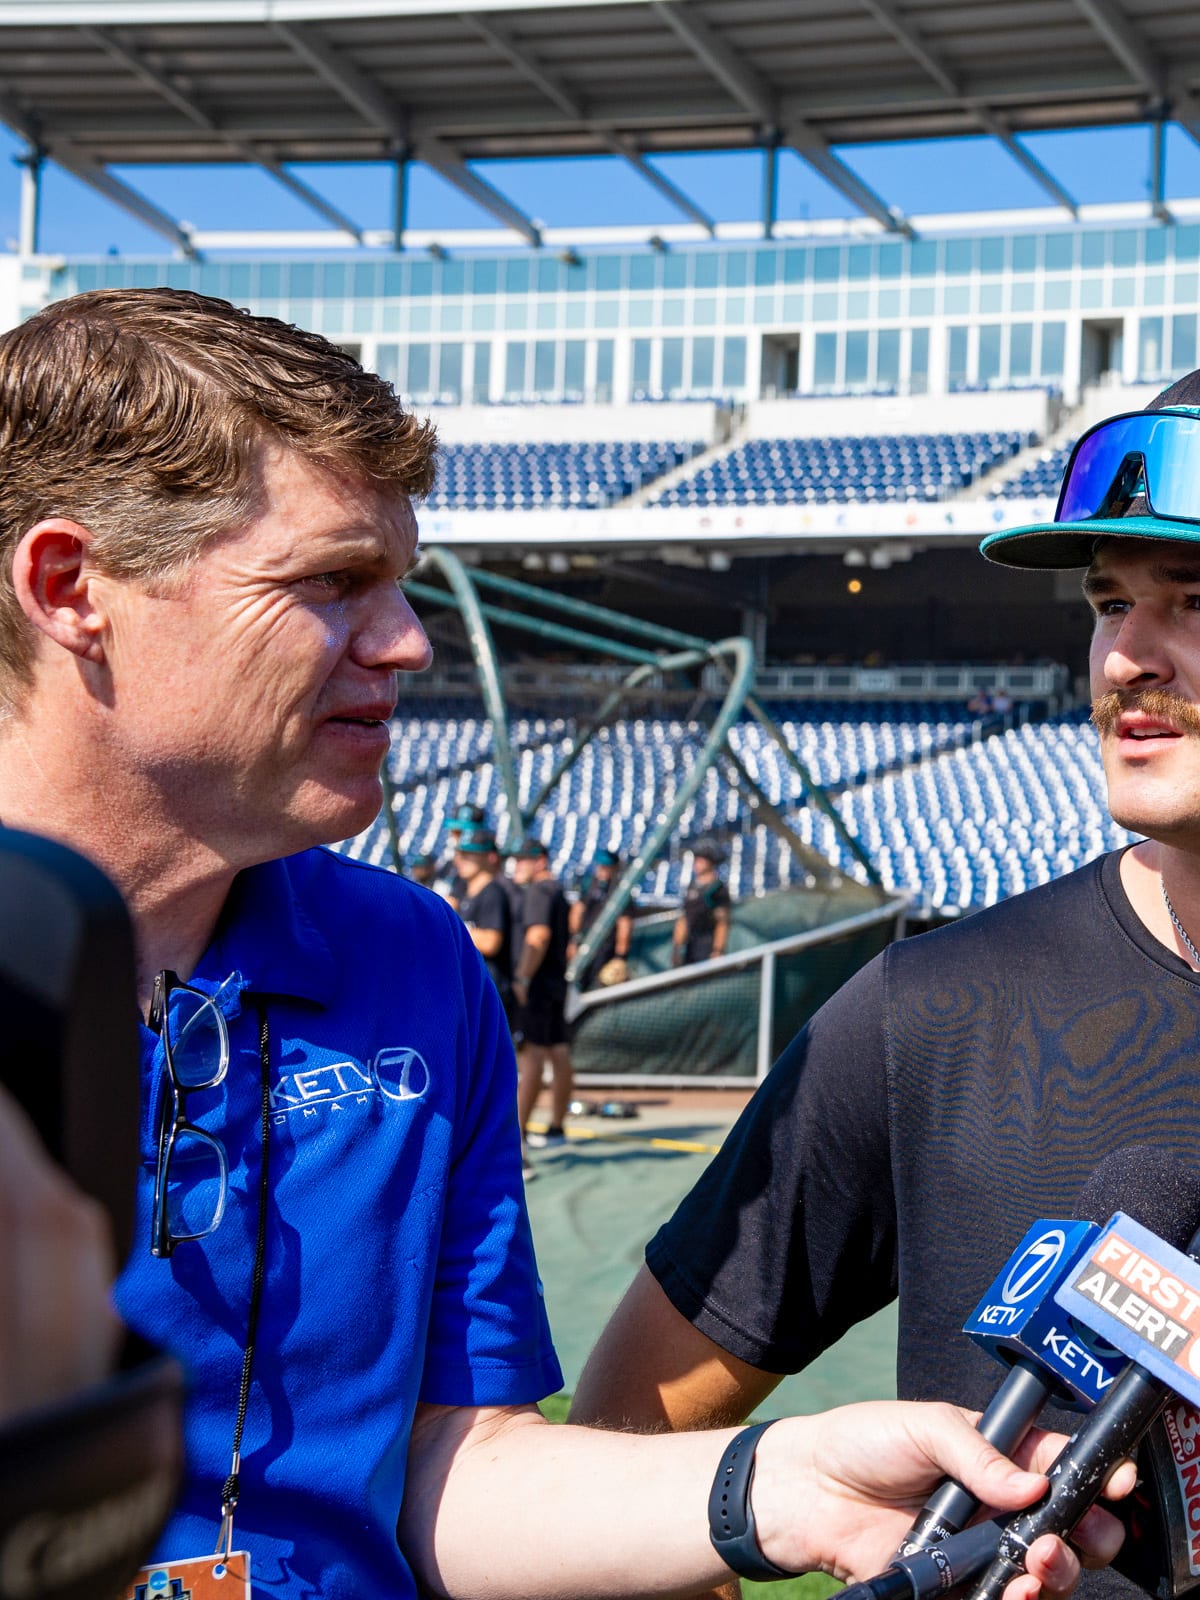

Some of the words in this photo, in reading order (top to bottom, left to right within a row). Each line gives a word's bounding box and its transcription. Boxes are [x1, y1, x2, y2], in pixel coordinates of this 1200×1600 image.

[269, 1059, 372, 1109] KETV
[377, 1049, 419, 1100] 7
[273, 1094, 369, 1126] OMAH
[1006, 1240, 1061, 1301] 7
[977, 1304, 1025, 1326] KETV
[1077, 1271, 1189, 1351] ALERT
[1042, 1326, 1115, 1390] KETV
[1164, 1409, 1185, 1462] KMTV
